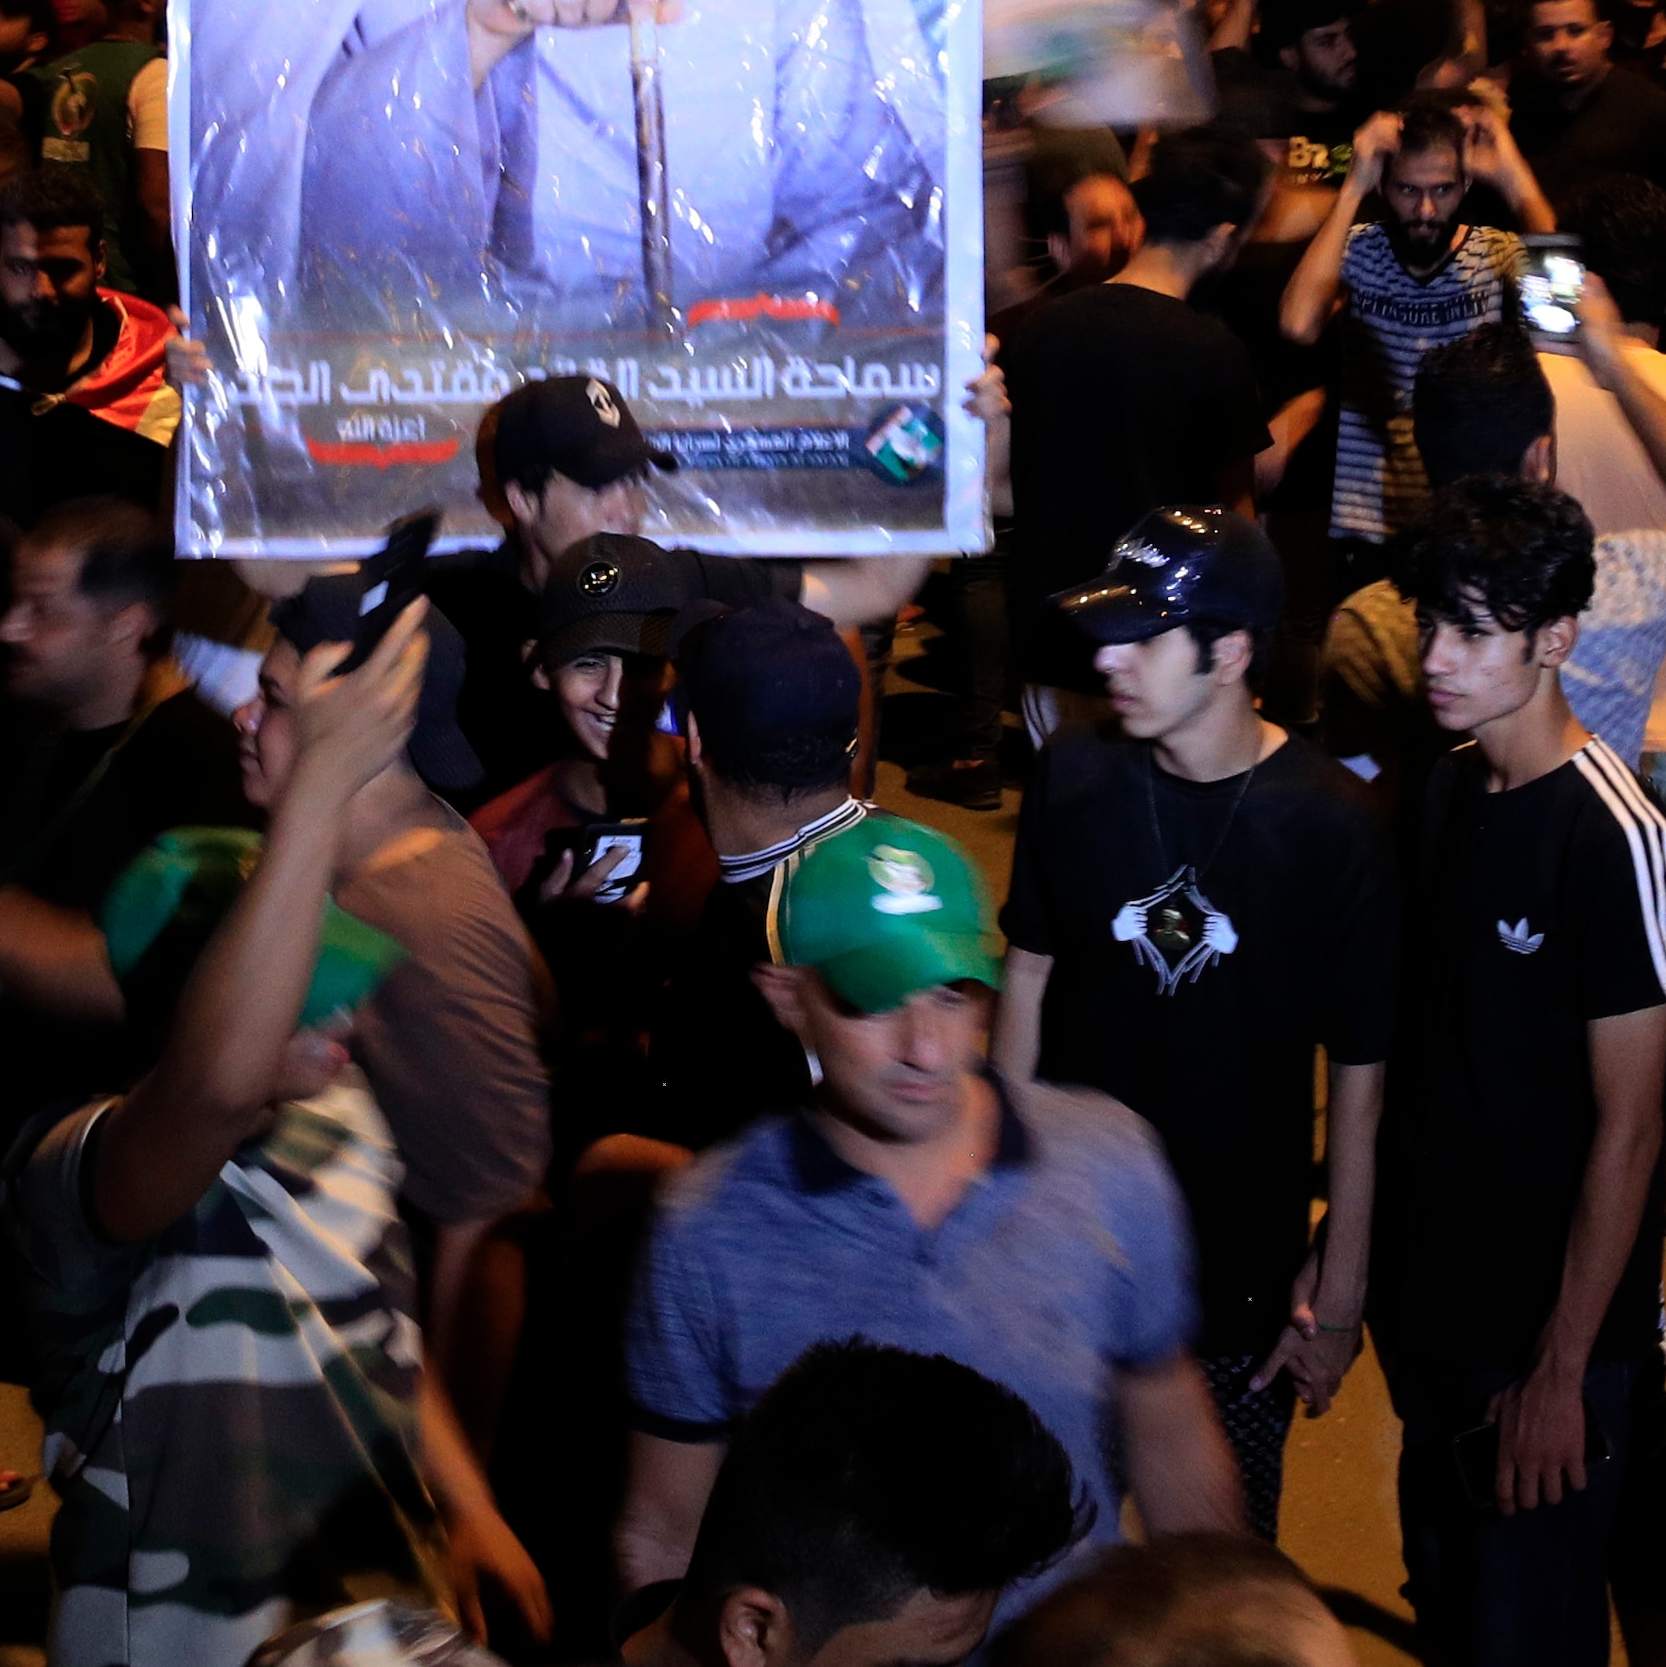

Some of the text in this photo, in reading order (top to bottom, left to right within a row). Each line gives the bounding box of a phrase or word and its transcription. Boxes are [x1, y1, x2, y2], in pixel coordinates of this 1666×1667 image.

[339, 358, 513, 404] مقتدى
[646, 354, 775, 410] السيد
[780, 354, 942, 399] سماحة
